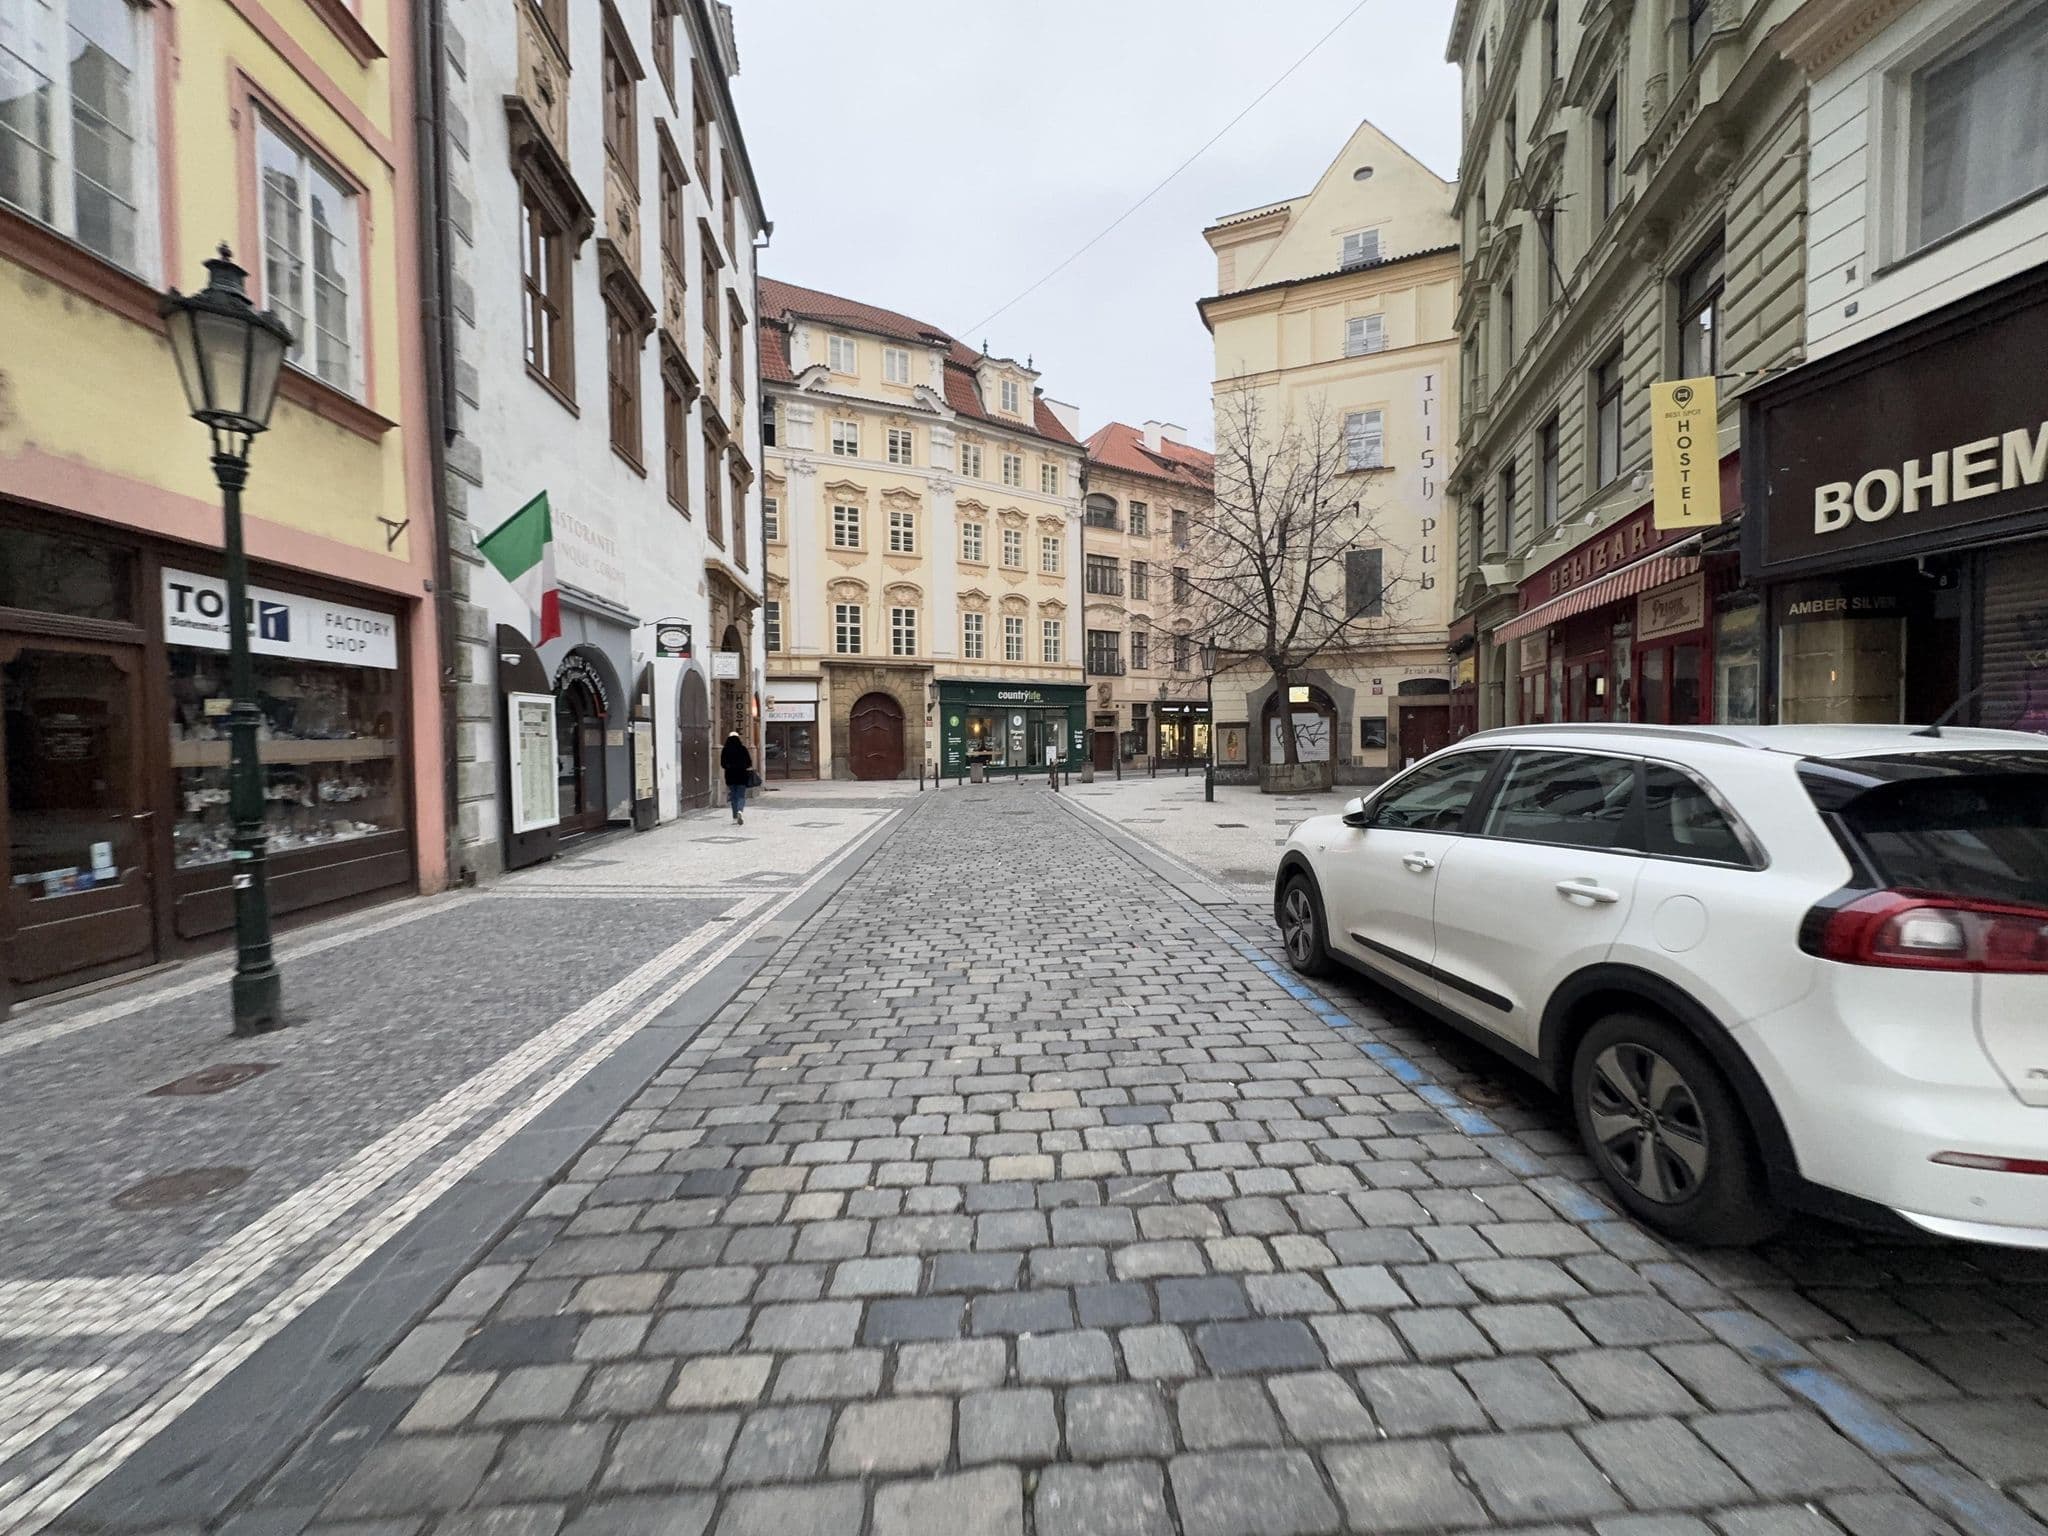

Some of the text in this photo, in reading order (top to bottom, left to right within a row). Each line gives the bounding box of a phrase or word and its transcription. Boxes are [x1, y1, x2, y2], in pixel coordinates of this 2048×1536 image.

[1664, 409, 1701, 419] BEST SPOT
[1677, 420, 1692, 516] HOSTEL
[1549, 519, 1663, 594] BELIZAR
[1789, 598, 1847, 615] AMBER
[325, 613, 390, 637] FACTORY
[326, 635, 367, 652] SHOP
[735, 693, 744, 736] HOSTE
